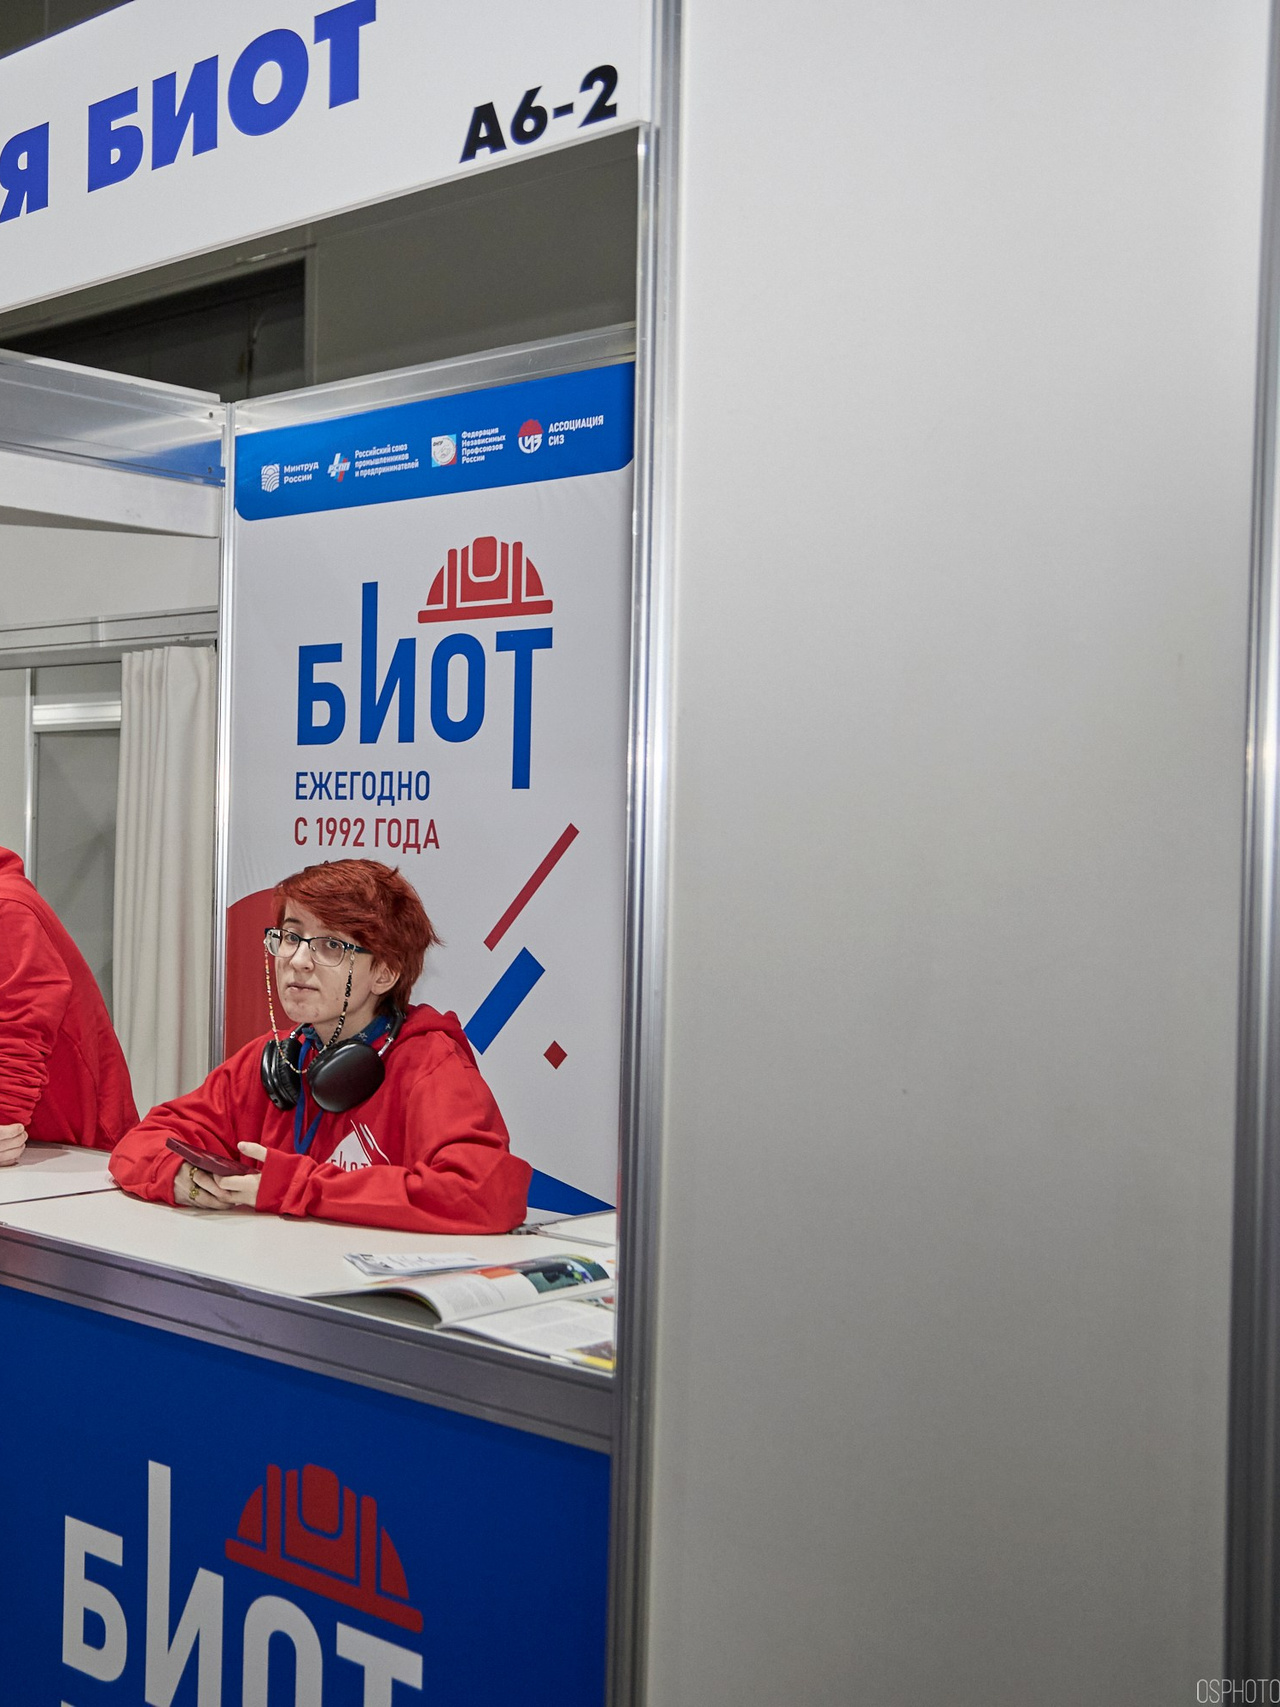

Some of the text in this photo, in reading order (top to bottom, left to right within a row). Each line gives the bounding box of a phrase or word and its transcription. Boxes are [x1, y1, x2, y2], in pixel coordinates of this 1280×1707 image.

[86, 0, 376, 193] БИОТ
[548, 414, 604, 434] АССОЦИАЦИЯ
[461, 427, 499, 440] Федерация
[461, 434, 507, 448] Независимых
[548, 434, 565, 447] СИЗ
[354, 443, 408, 458] Российский союз
[461, 443, 504, 456] Профсоюзов
[354, 453, 410, 468] промышленников
[461, 454, 486, 464] России
[283, 461, 320, 474] Минтруд
[360, 459, 420, 477] предпринимателей
[283, 474, 313, 484] России
[296, 581, 554, 790] БИОТ
[295, 770, 431, 806] ЕЖЕГОДНО
[316, 816, 366, 848] 1992
[375, 818, 440, 855] ГОДА
